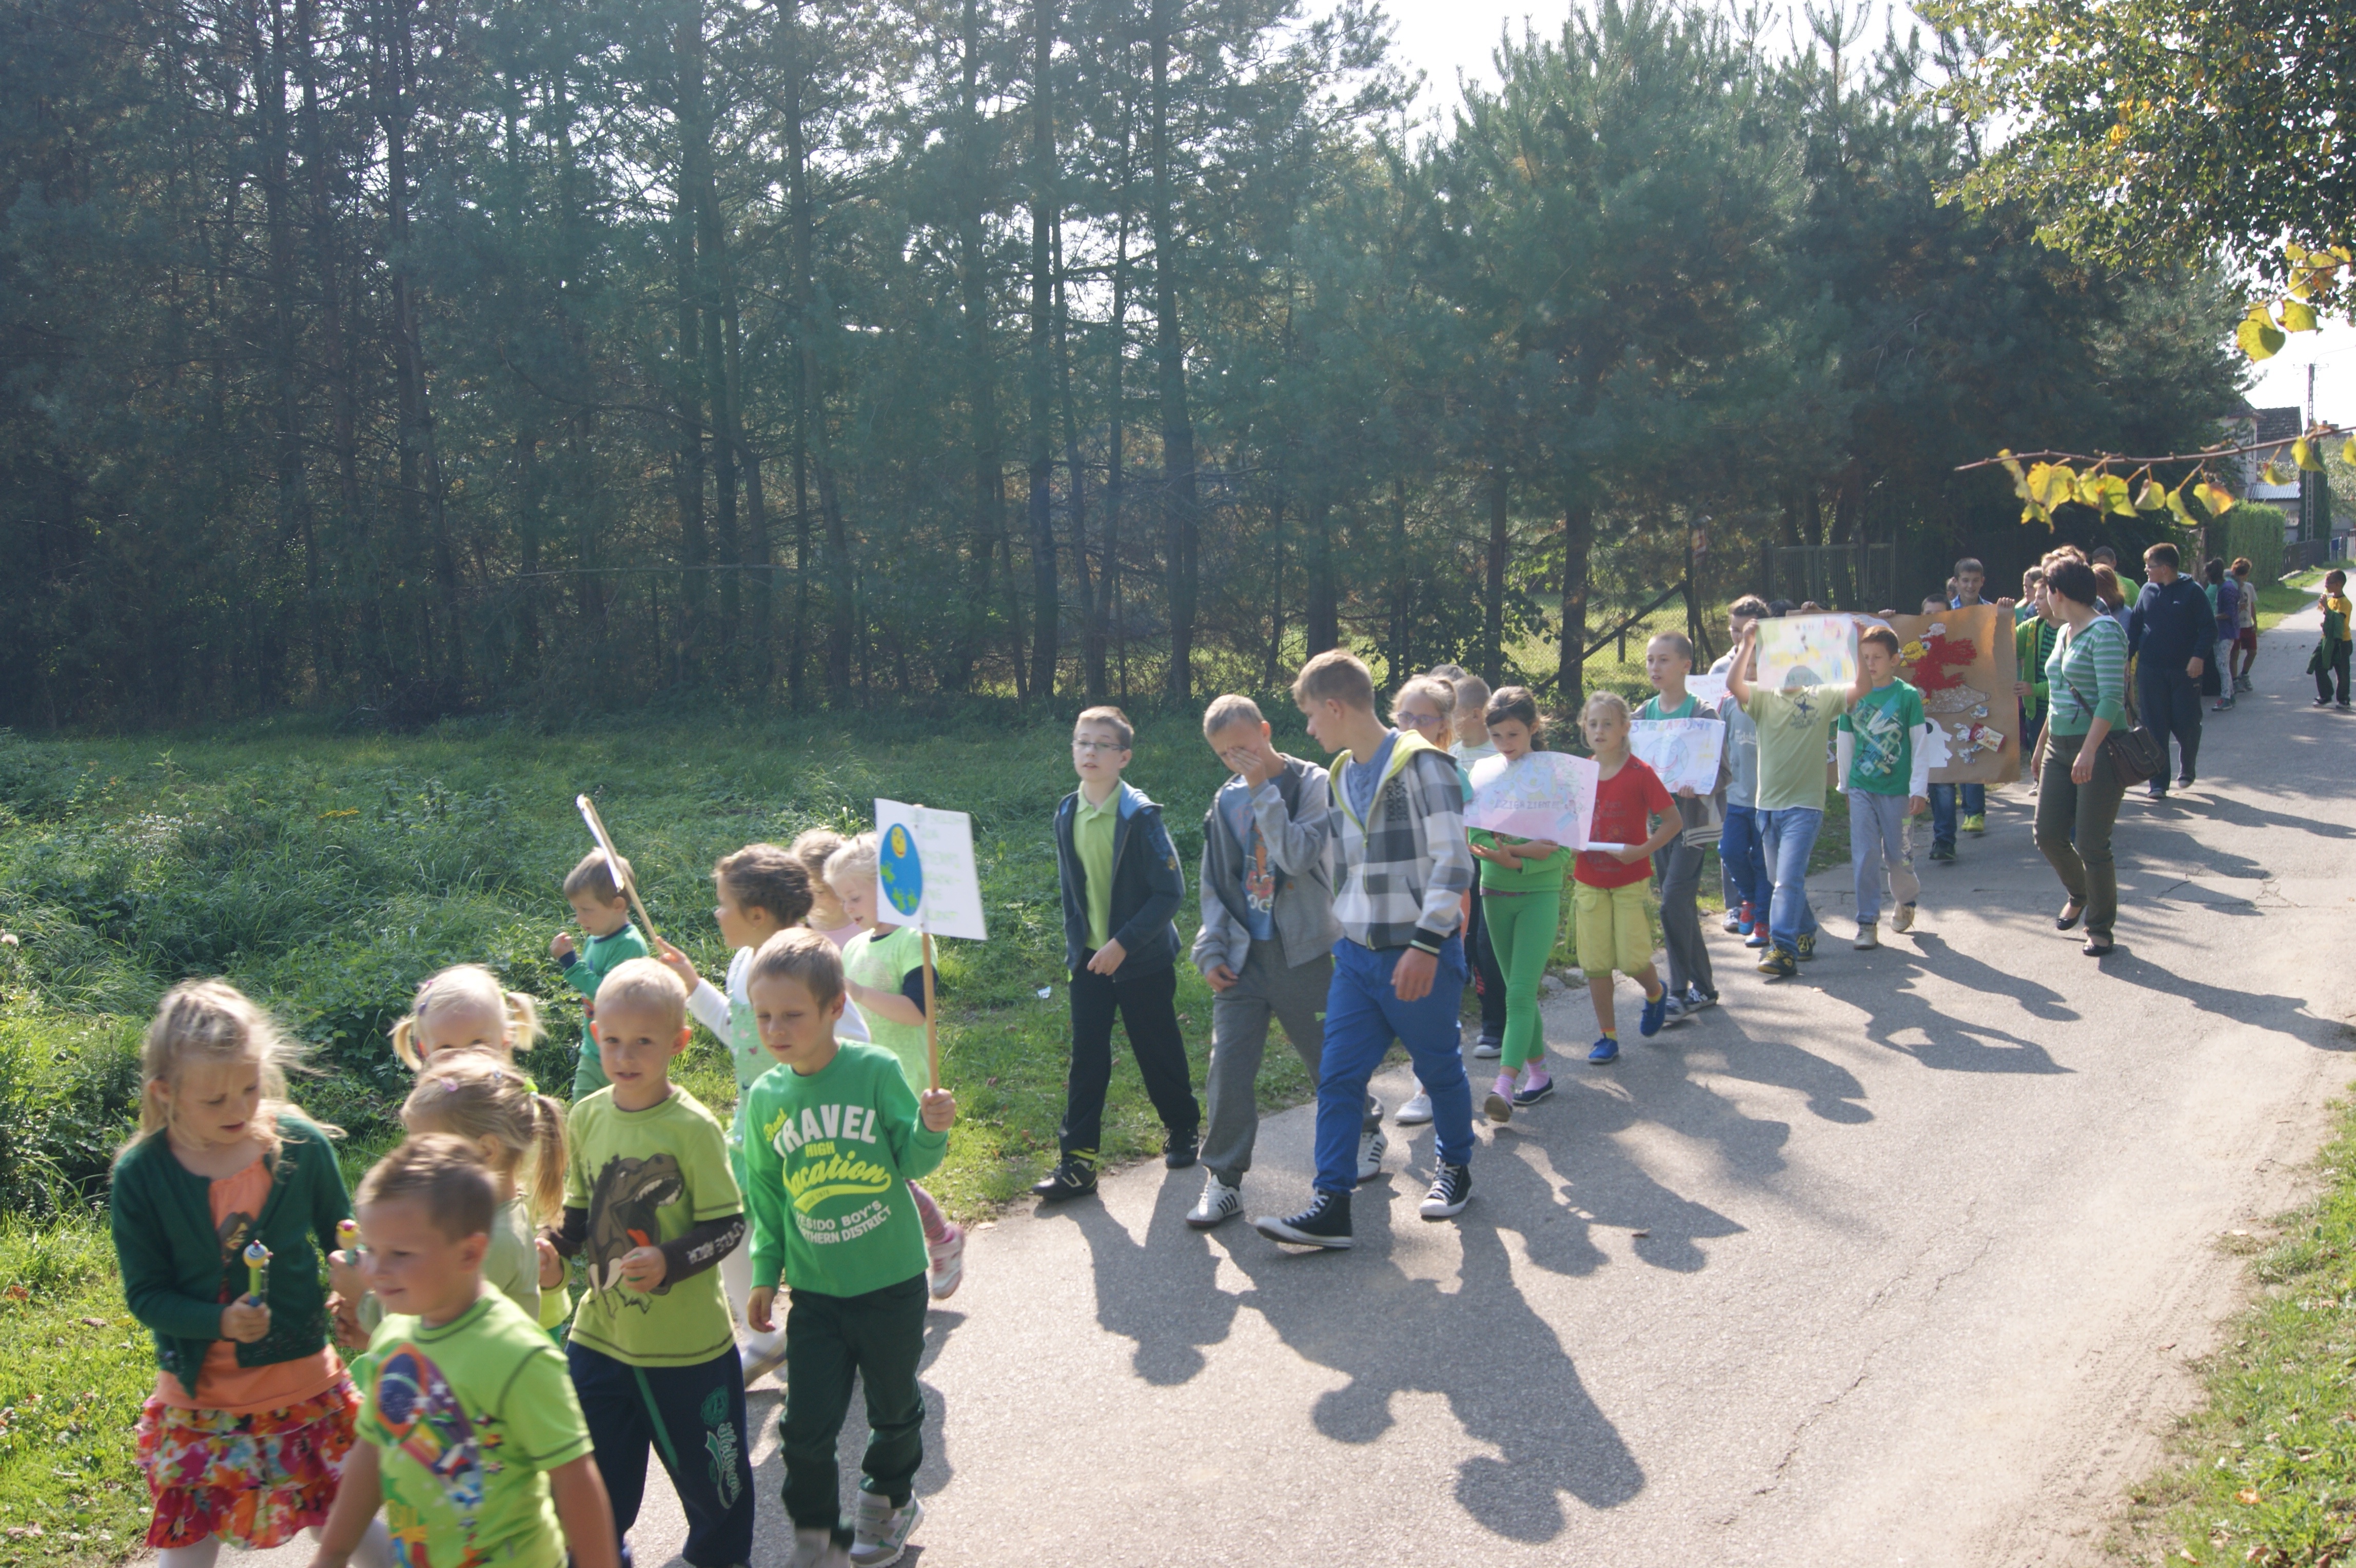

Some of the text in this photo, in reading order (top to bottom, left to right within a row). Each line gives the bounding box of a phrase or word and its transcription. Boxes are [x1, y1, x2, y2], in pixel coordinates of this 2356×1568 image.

[773, 1104, 876, 1159] TRAVEL
[805, 1141, 836, 1158] HIGH
[841, 1200, 882, 1227] BOY'S
[841, 1205, 891, 1242] DISTRICT
